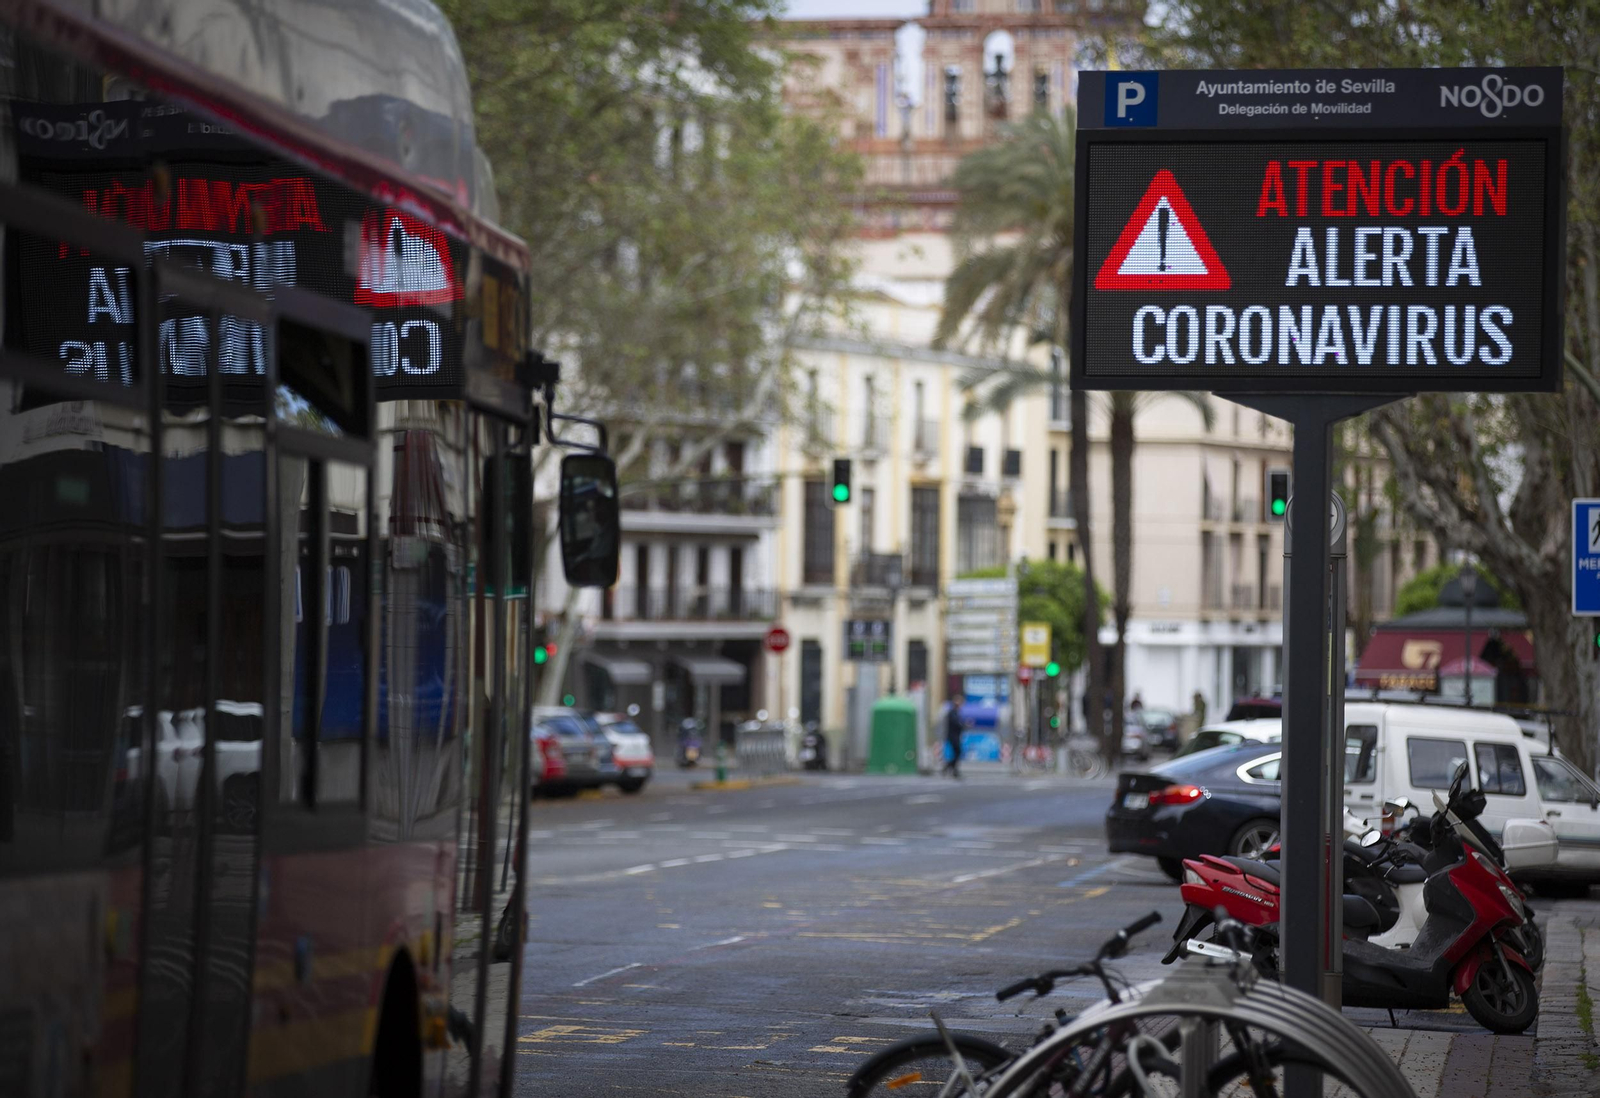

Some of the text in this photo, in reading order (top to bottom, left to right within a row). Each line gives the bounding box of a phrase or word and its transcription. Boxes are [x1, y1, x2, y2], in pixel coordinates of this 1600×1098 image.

[1117, 81, 1146, 118] P
[1196, 79, 1396, 97] Ayuntamiento de Sevilla
[1218, 102, 1372, 116] Delegación de Movilidad
[1256, 148, 1508, 217] ATENCIÓN
[1285, 226, 1482, 287] ALERTA
[1132, 304, 1514, 366] CORONAVIRUS
[1579, 557, 1600, 570] ME
